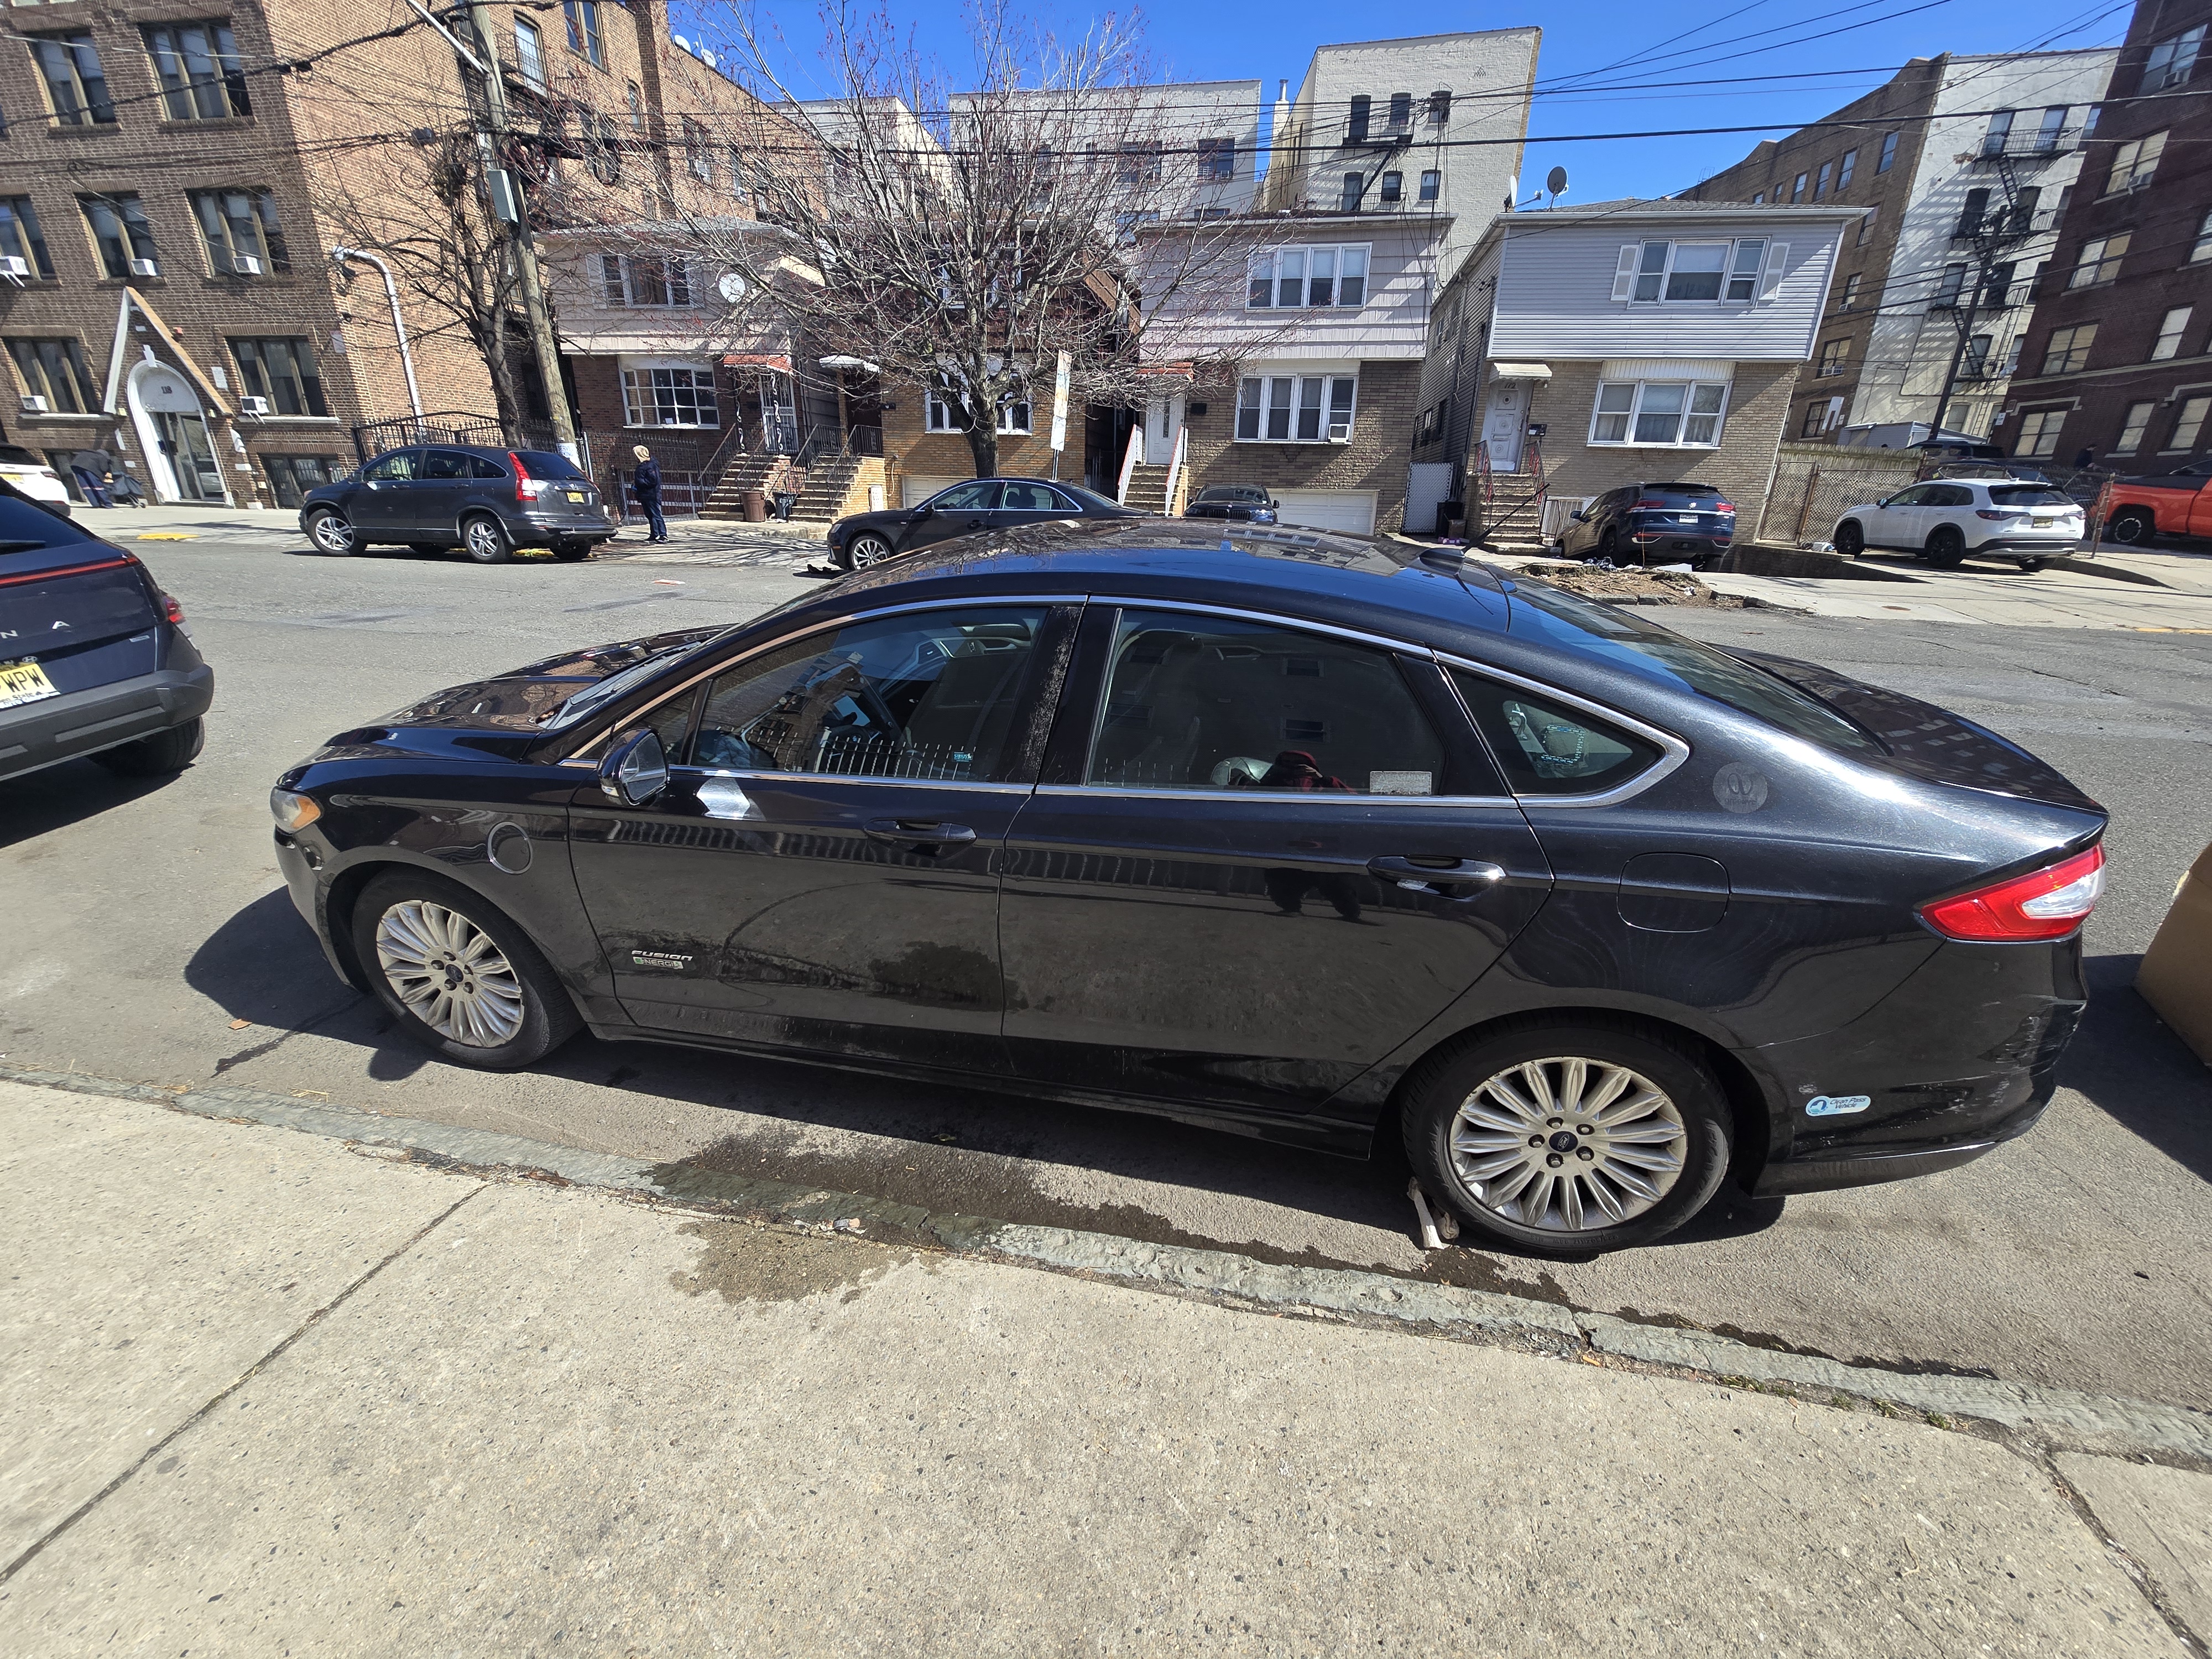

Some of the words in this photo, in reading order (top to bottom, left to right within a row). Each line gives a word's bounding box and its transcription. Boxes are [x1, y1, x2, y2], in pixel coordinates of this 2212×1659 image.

[1, 669, 45, 692] WPW
[631, 950, 693, 961] FUSION
[1558, 1135, 1568, 1149] Ford
